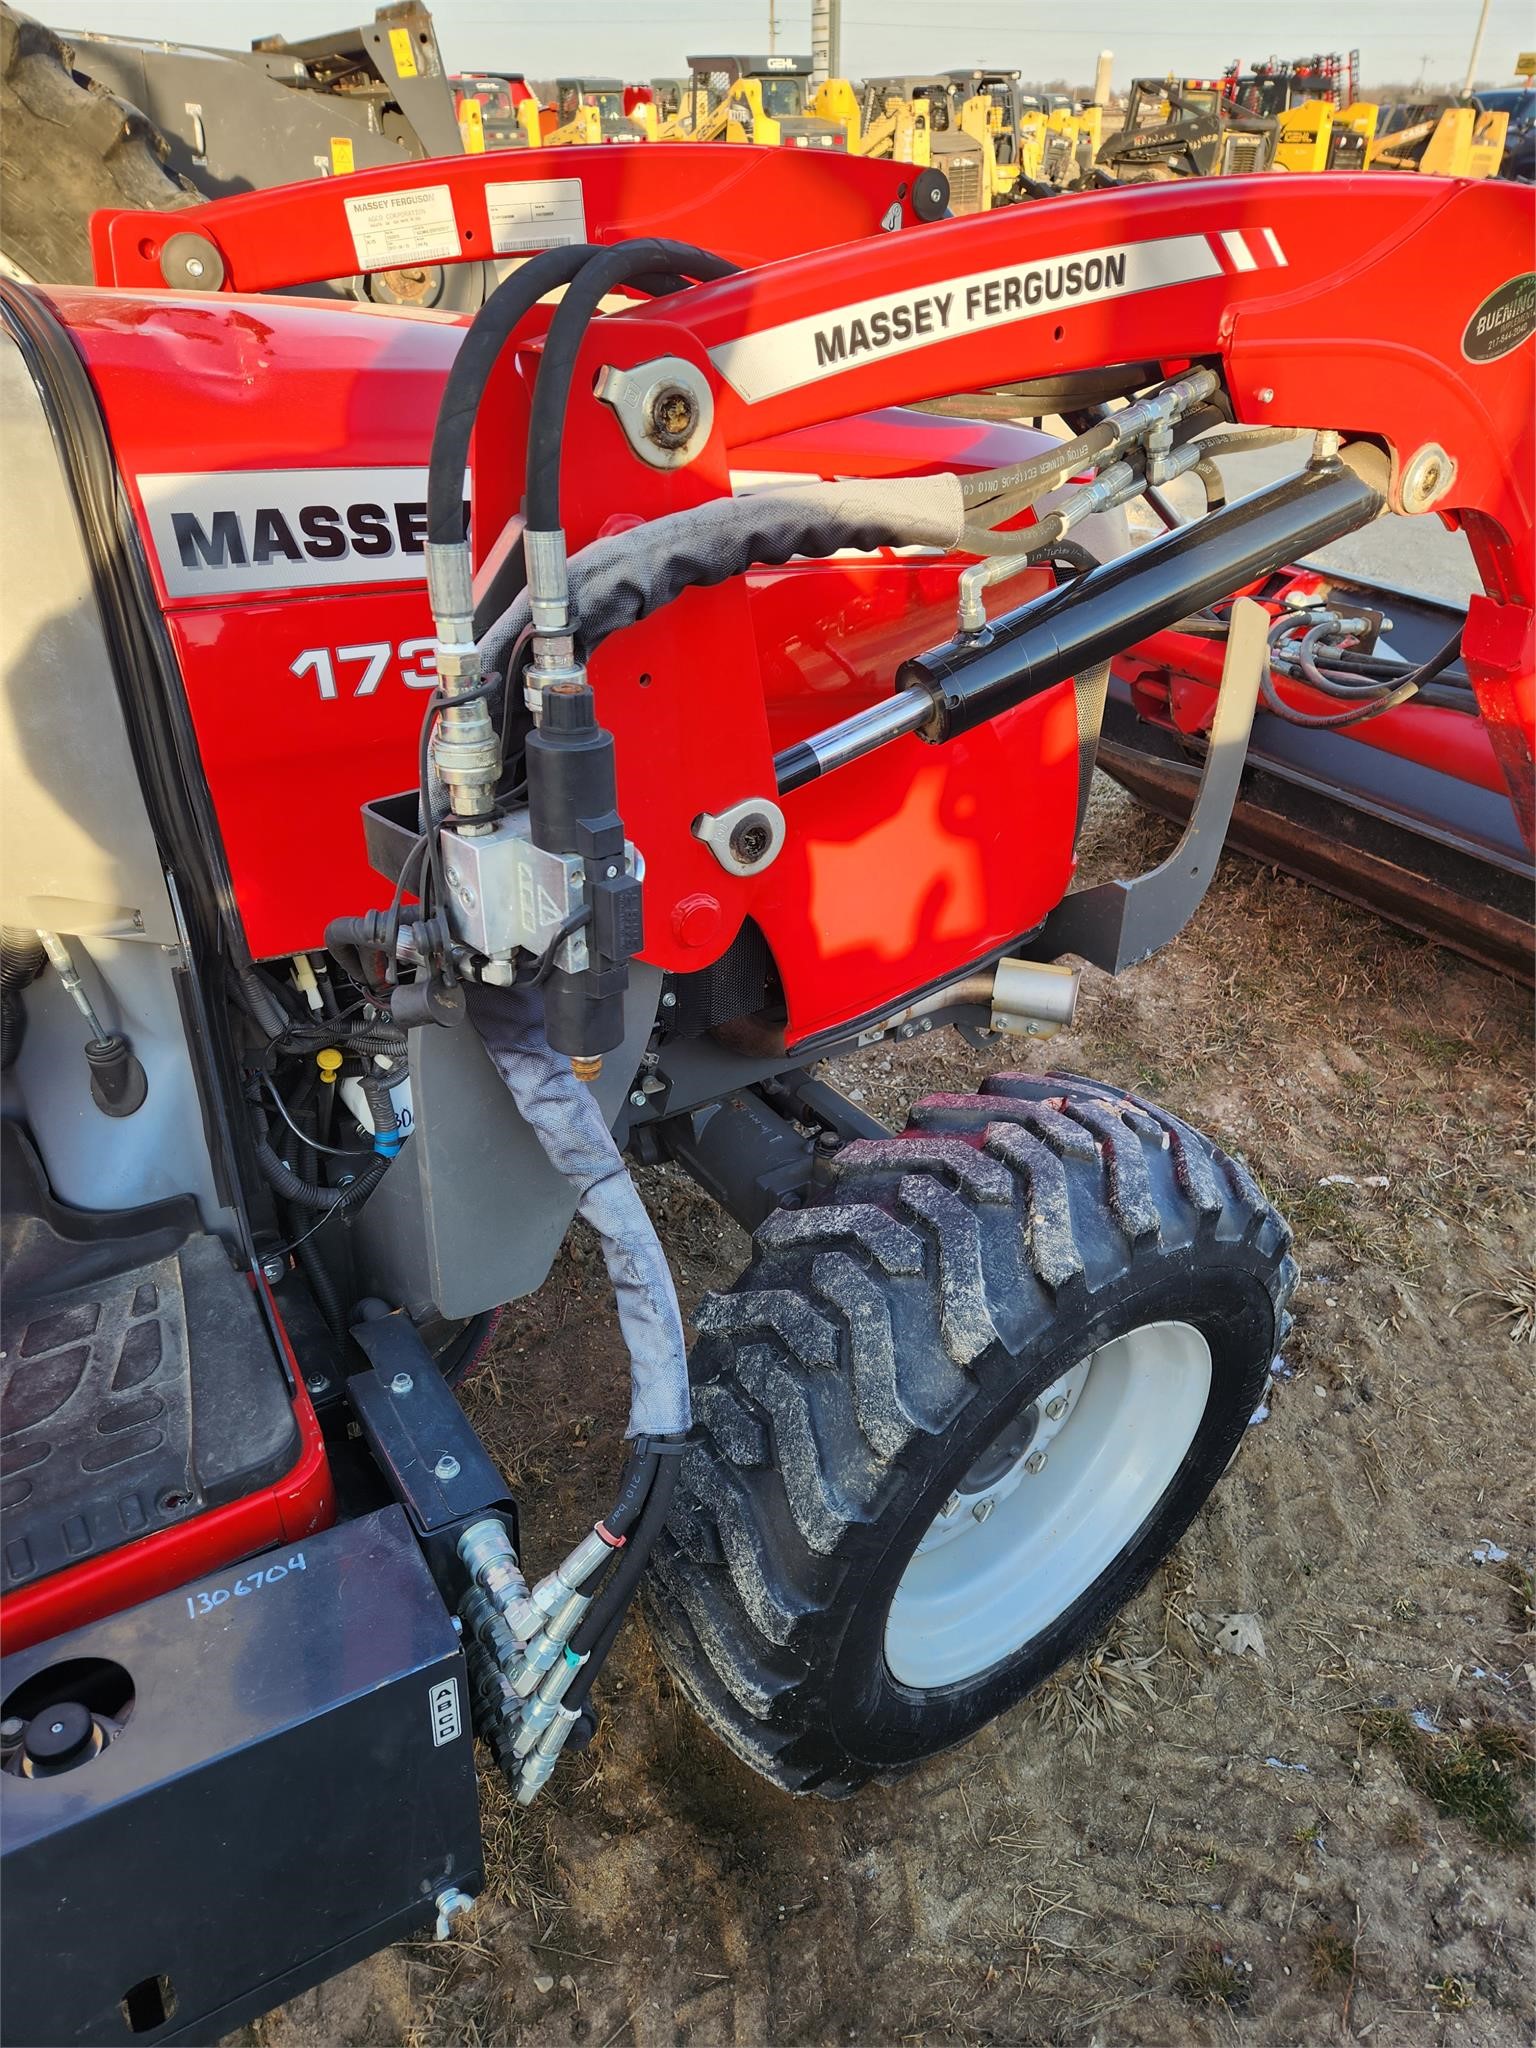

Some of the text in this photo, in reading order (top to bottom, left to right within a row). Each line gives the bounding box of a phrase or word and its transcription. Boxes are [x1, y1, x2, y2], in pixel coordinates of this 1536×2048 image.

[767, 58, 797, 70] GEHL
[353, 193, 435, 213] MASSEY FERGUSON
[813, 253, 1127, 367] MASSEY FERGUSON
[171, 500, 471, 571] MASSE
[187, 1553, 307, 1619] 1306704
